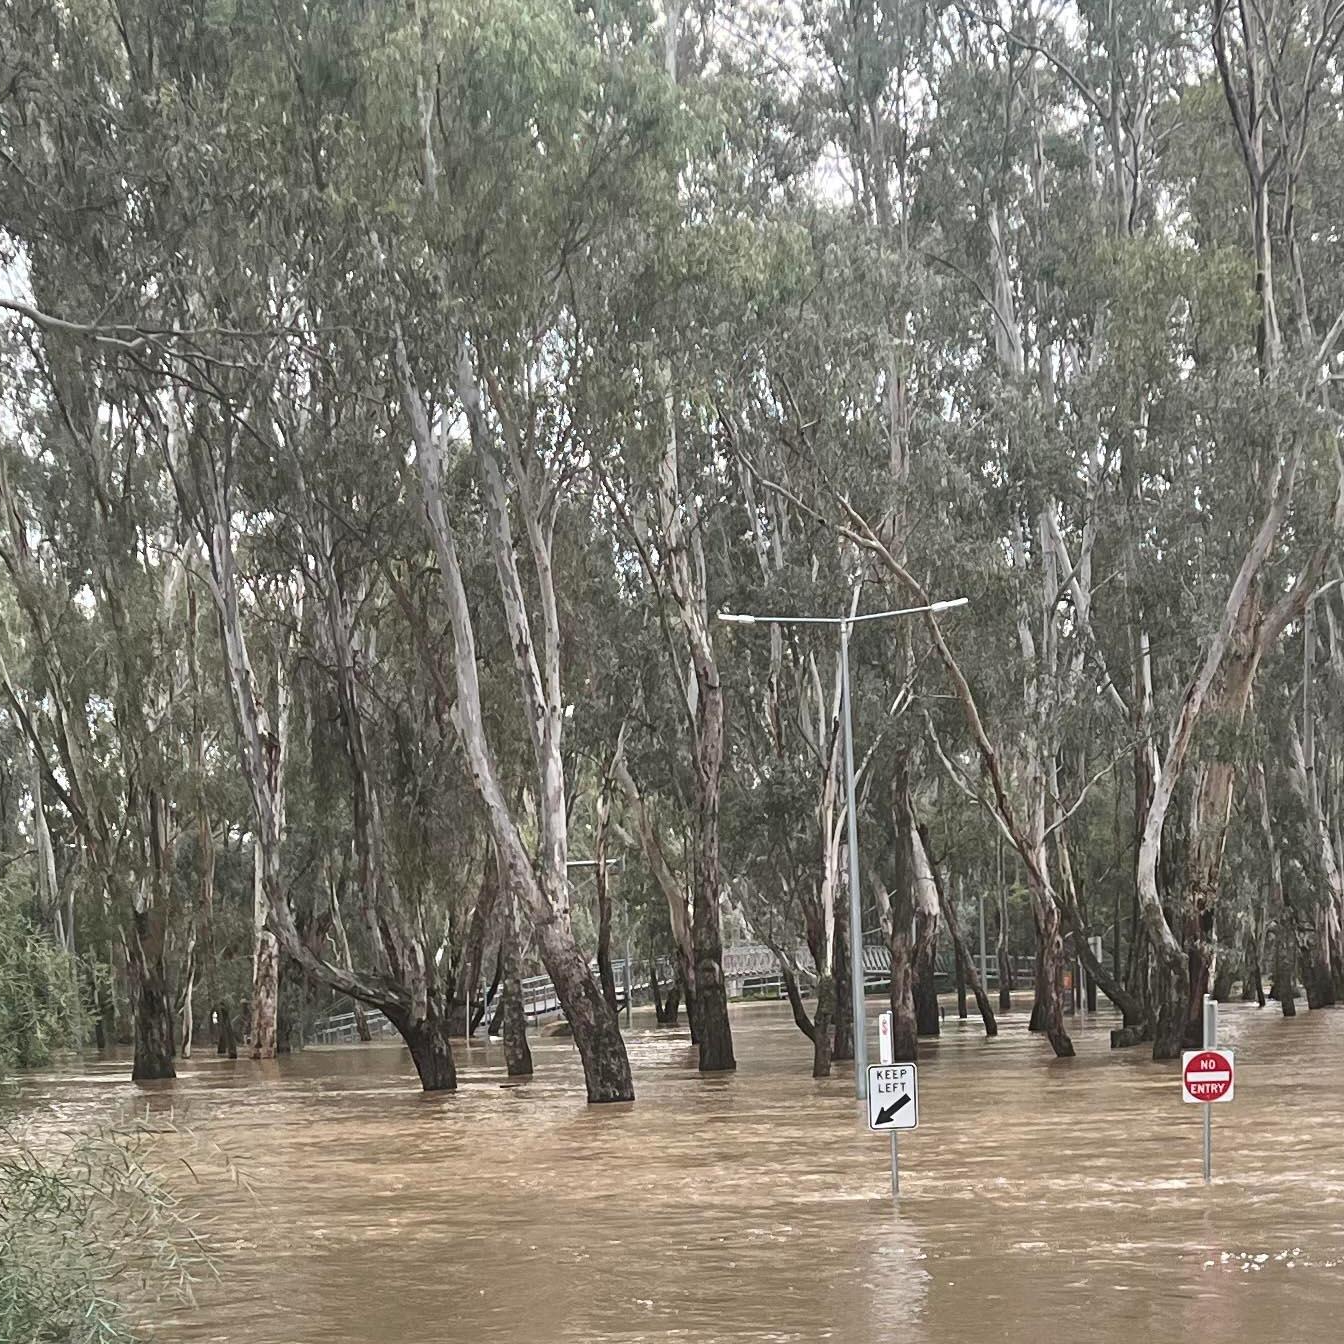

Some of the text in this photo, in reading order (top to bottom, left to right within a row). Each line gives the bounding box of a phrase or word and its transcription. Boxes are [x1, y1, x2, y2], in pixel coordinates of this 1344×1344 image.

[1200, 1059, 1216, 1070] NO
[876, 1069, 907, 1080] KEEP
[878, 1082, 906, 1093] LEFT
[1190, 1083, 1225, 1094] ENTRY
